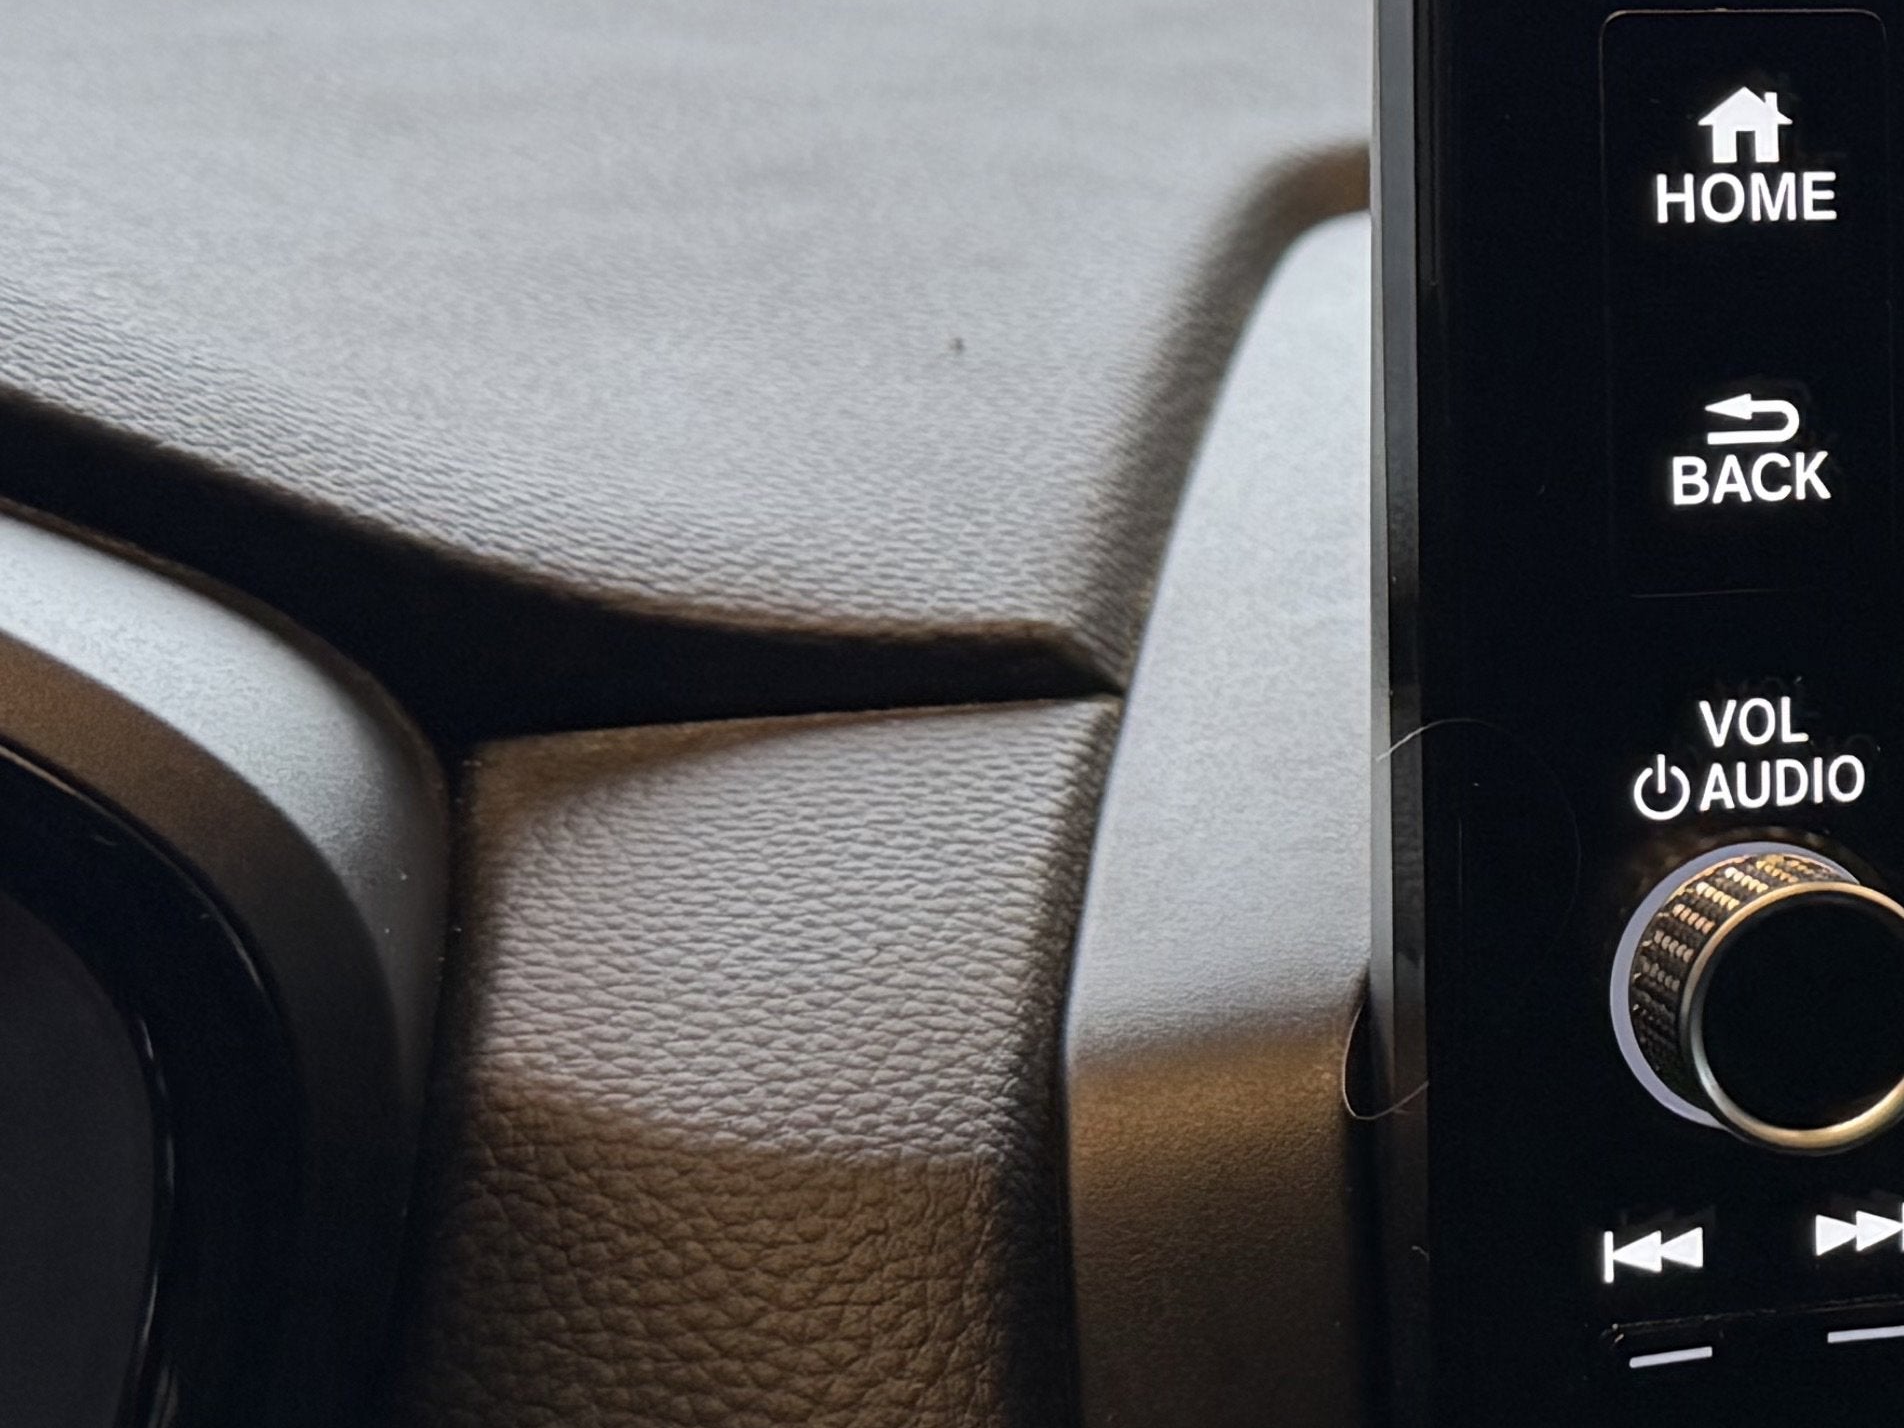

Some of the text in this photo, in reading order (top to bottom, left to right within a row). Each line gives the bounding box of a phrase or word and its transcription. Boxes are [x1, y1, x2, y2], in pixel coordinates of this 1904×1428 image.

[1656, 171, 1837, 224] HOME
[1672, 450, 1831, 507] BACK
[1699, 696, 1809, 748] VOL
[1700, 754, 1865, 812] AUDIO
